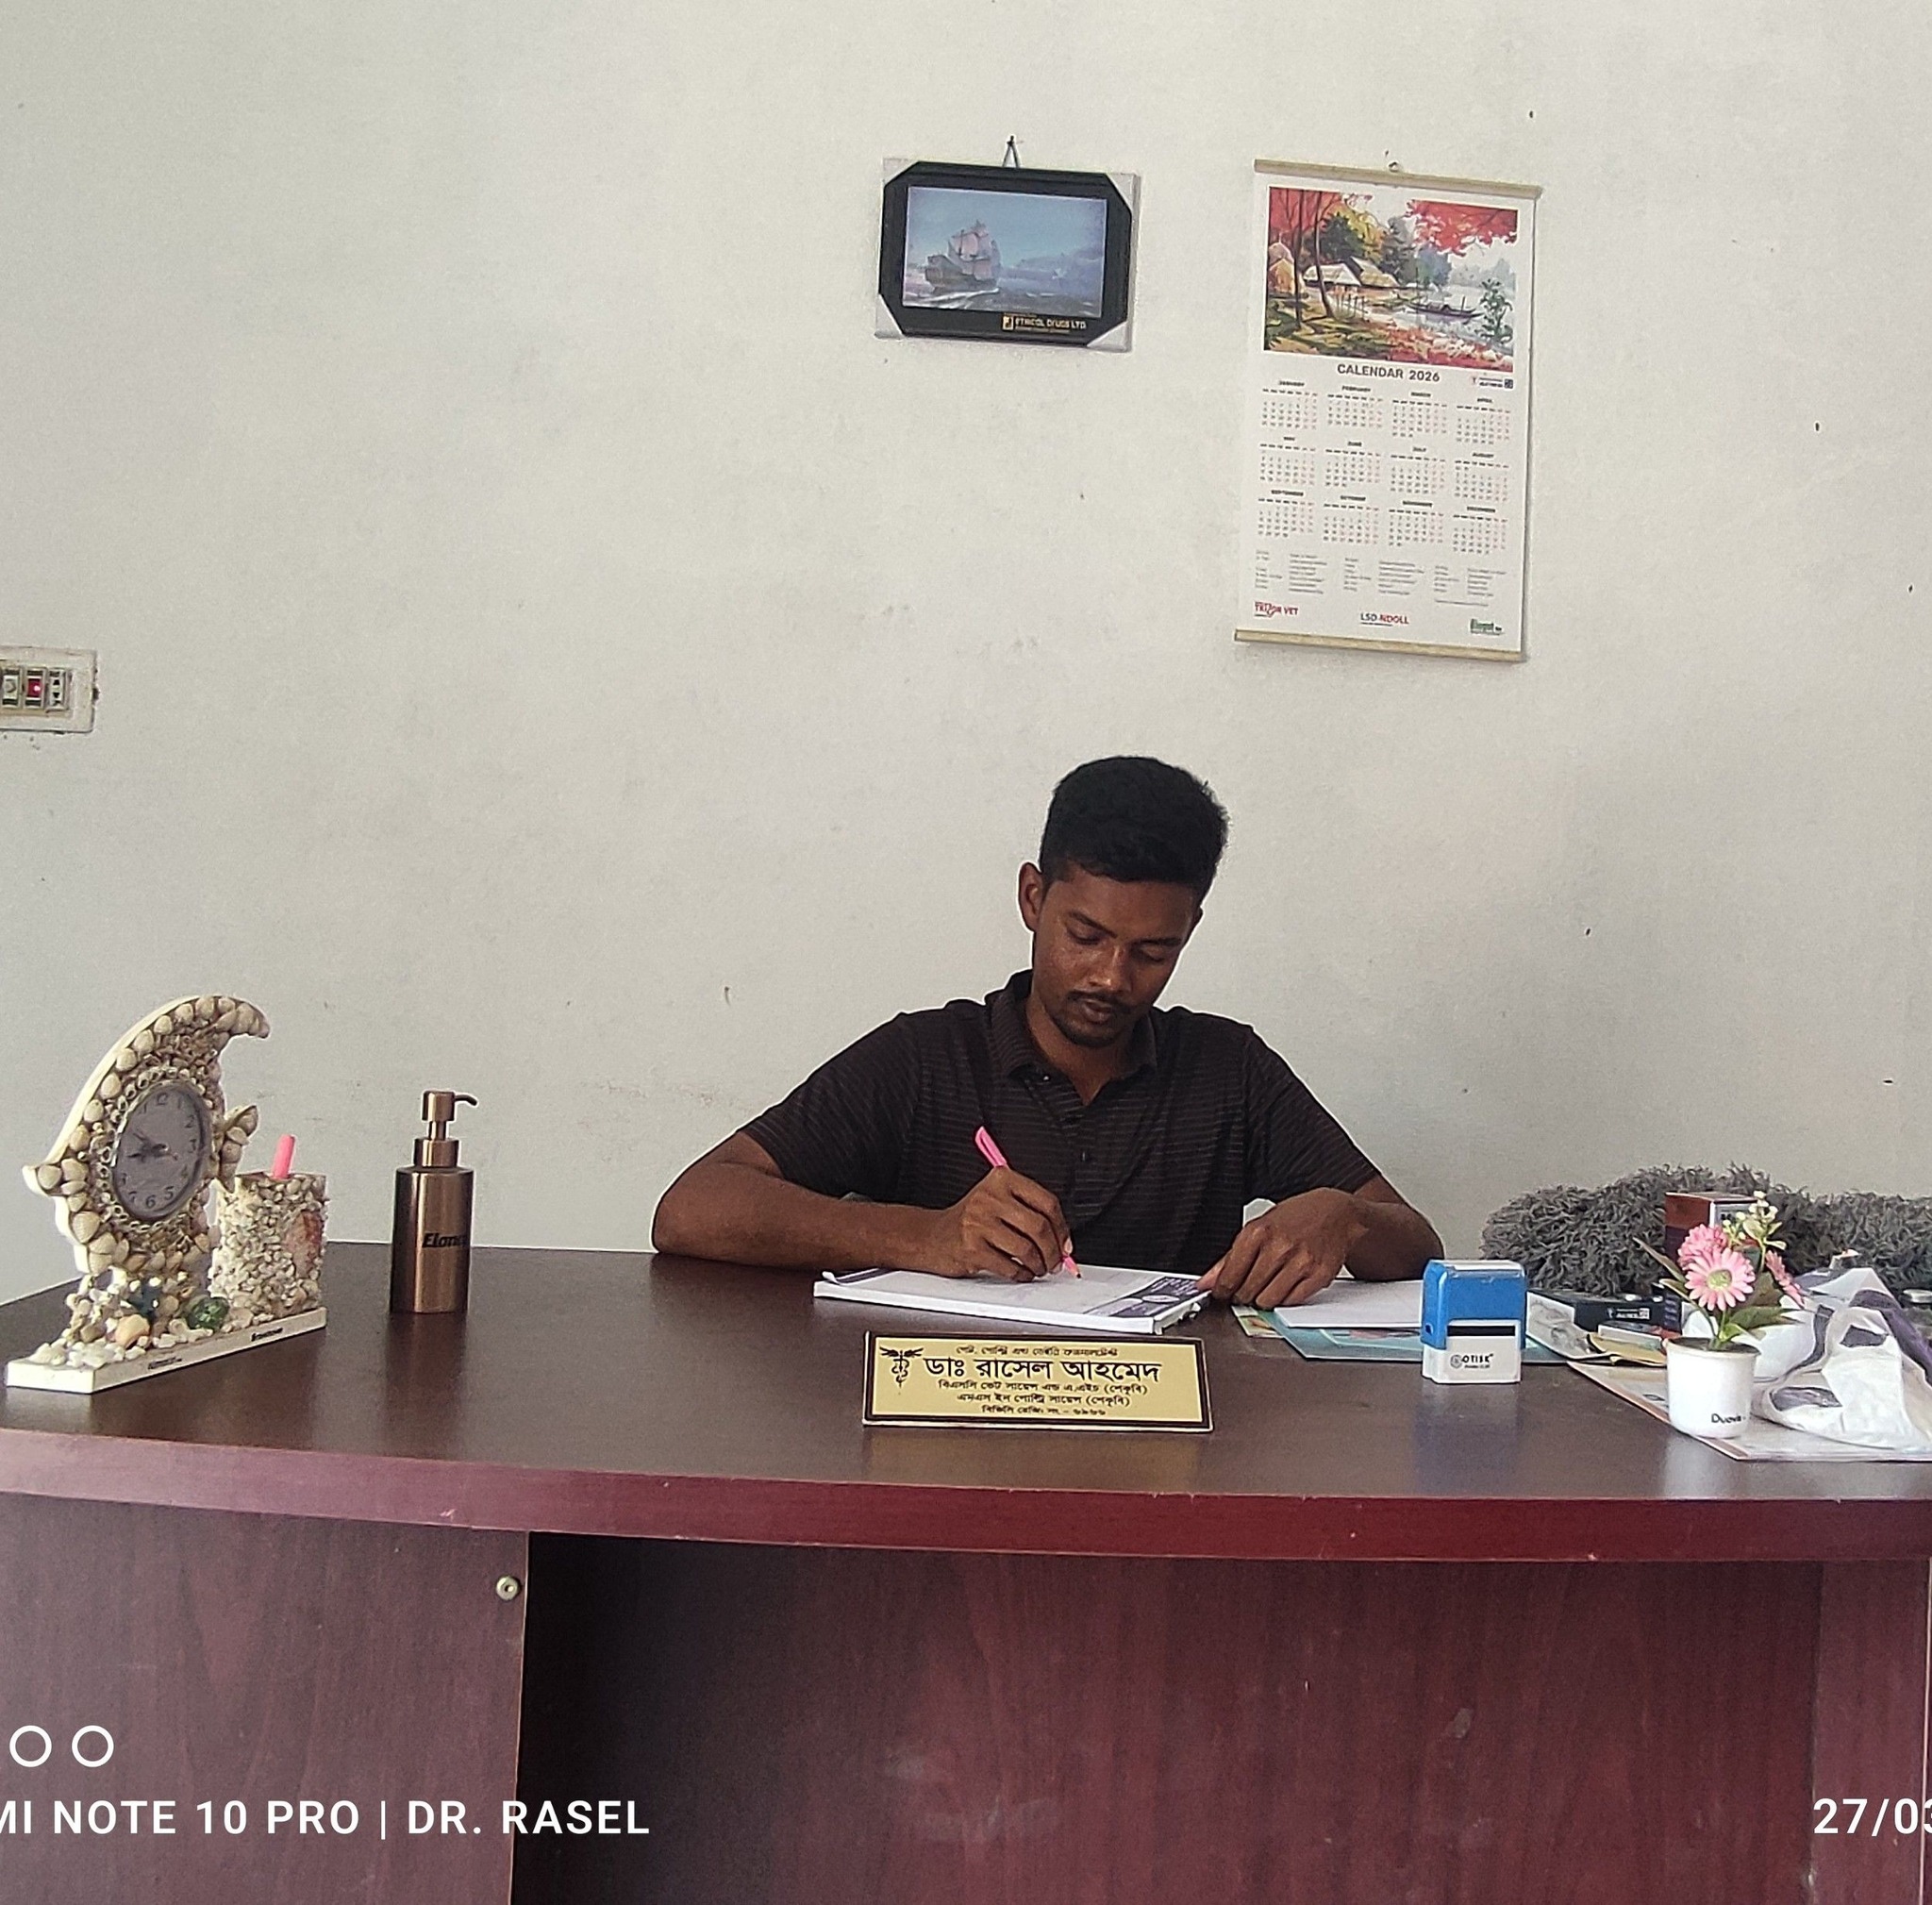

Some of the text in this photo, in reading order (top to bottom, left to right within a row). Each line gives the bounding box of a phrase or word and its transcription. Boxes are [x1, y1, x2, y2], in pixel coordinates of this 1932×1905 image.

[1337, 363, 1441, 382] CALENDAR 2026
[1284, 607, 1299, 615] VET
[974, 1359, 1053, 1379] রাসেল
[1060, 1361, 1162, 1382] আহমেদ
